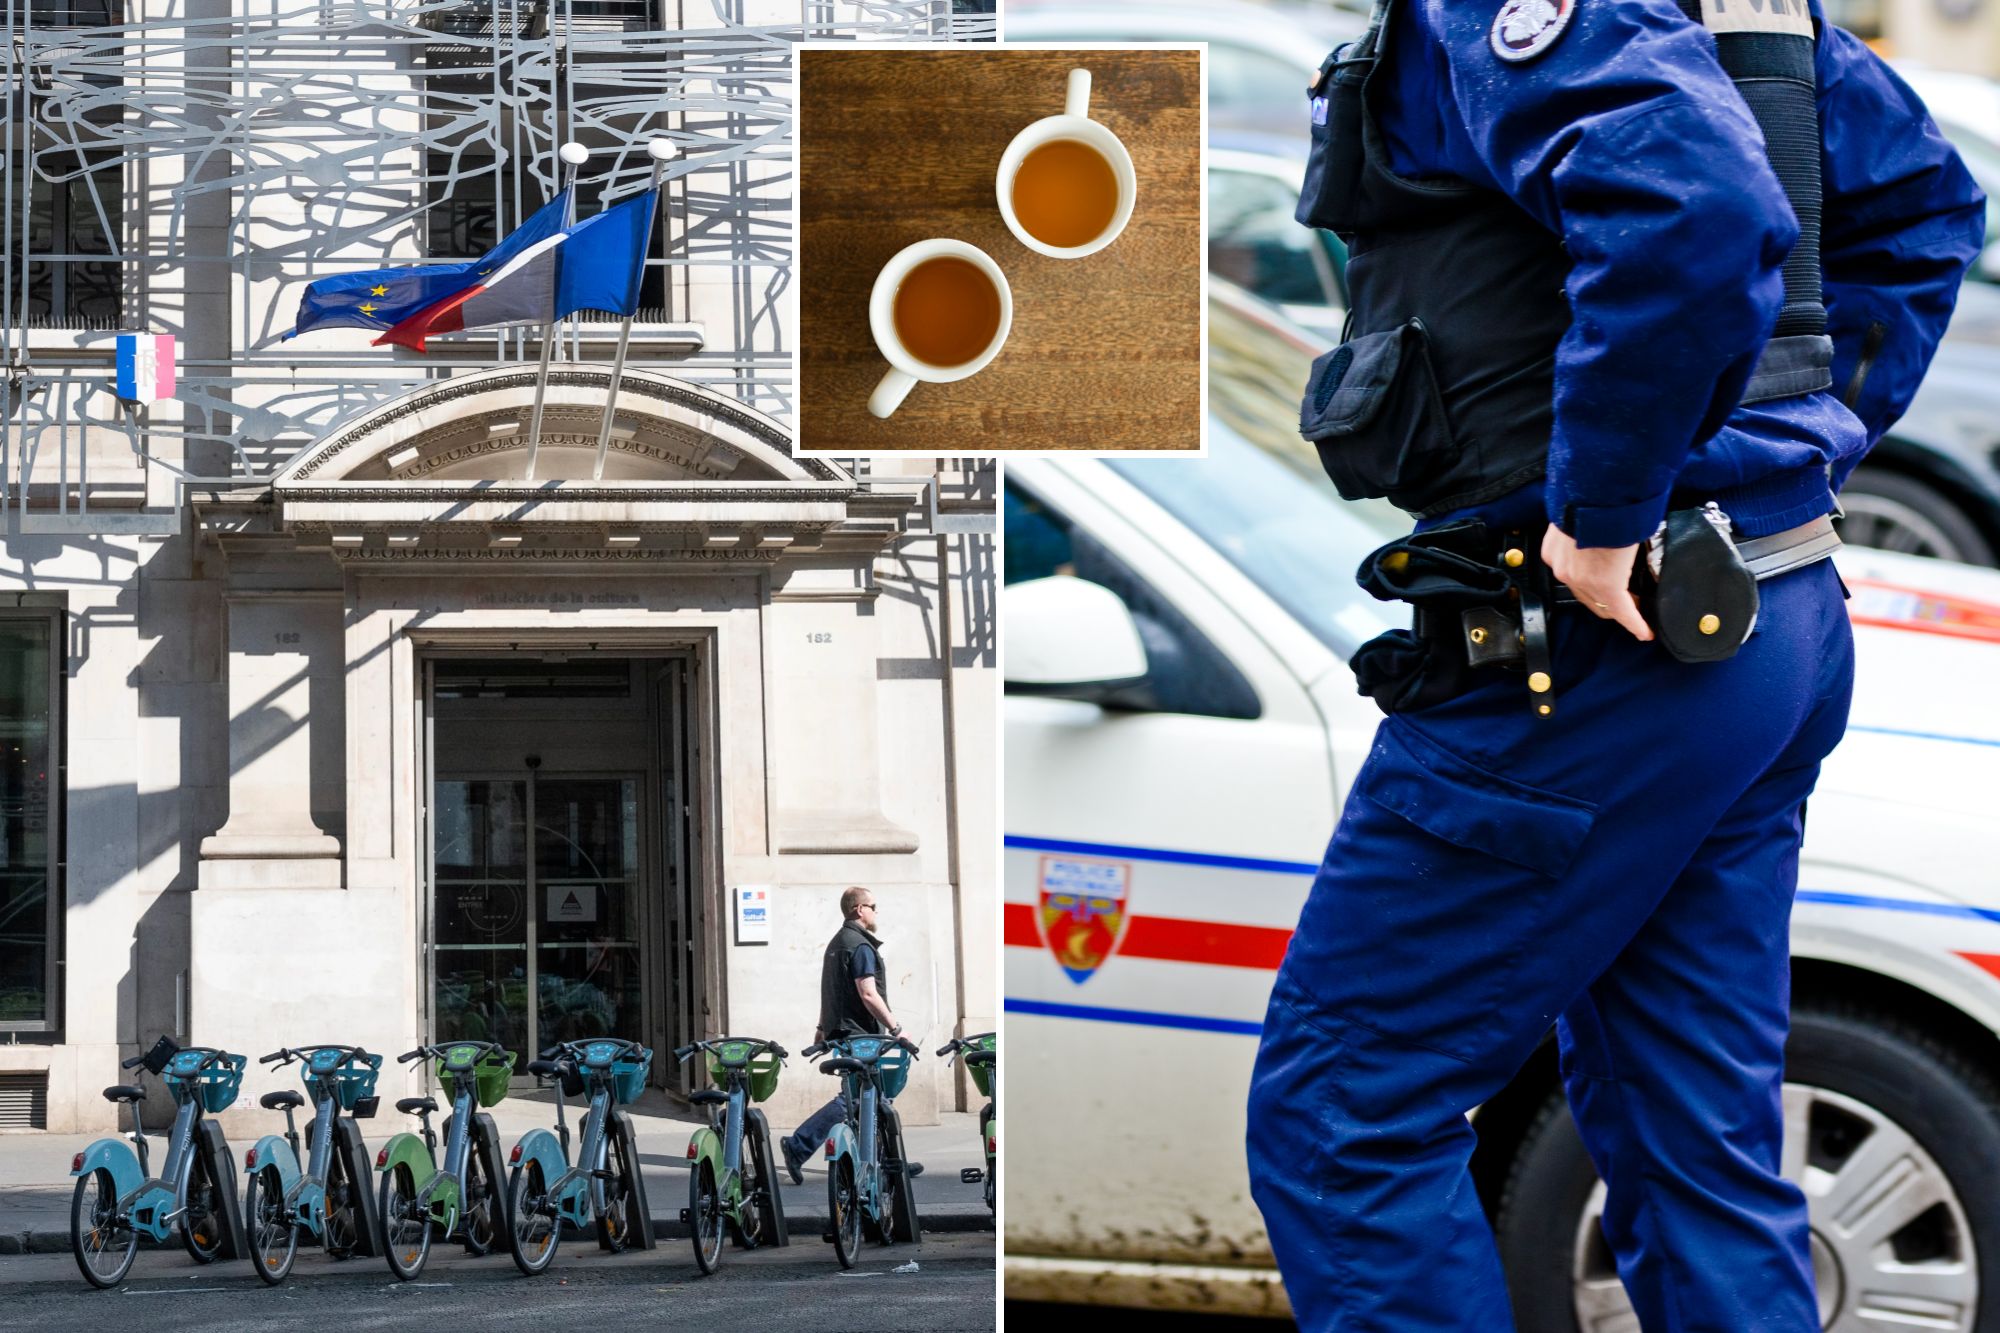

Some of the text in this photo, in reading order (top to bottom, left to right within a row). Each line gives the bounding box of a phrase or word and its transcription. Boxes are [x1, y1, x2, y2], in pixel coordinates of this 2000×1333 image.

[550, 591, 567, 604] de
[570, 591, 584, 604] la
[588, 591, 640, 604] culture
[806, 631, 832, 643] 182
